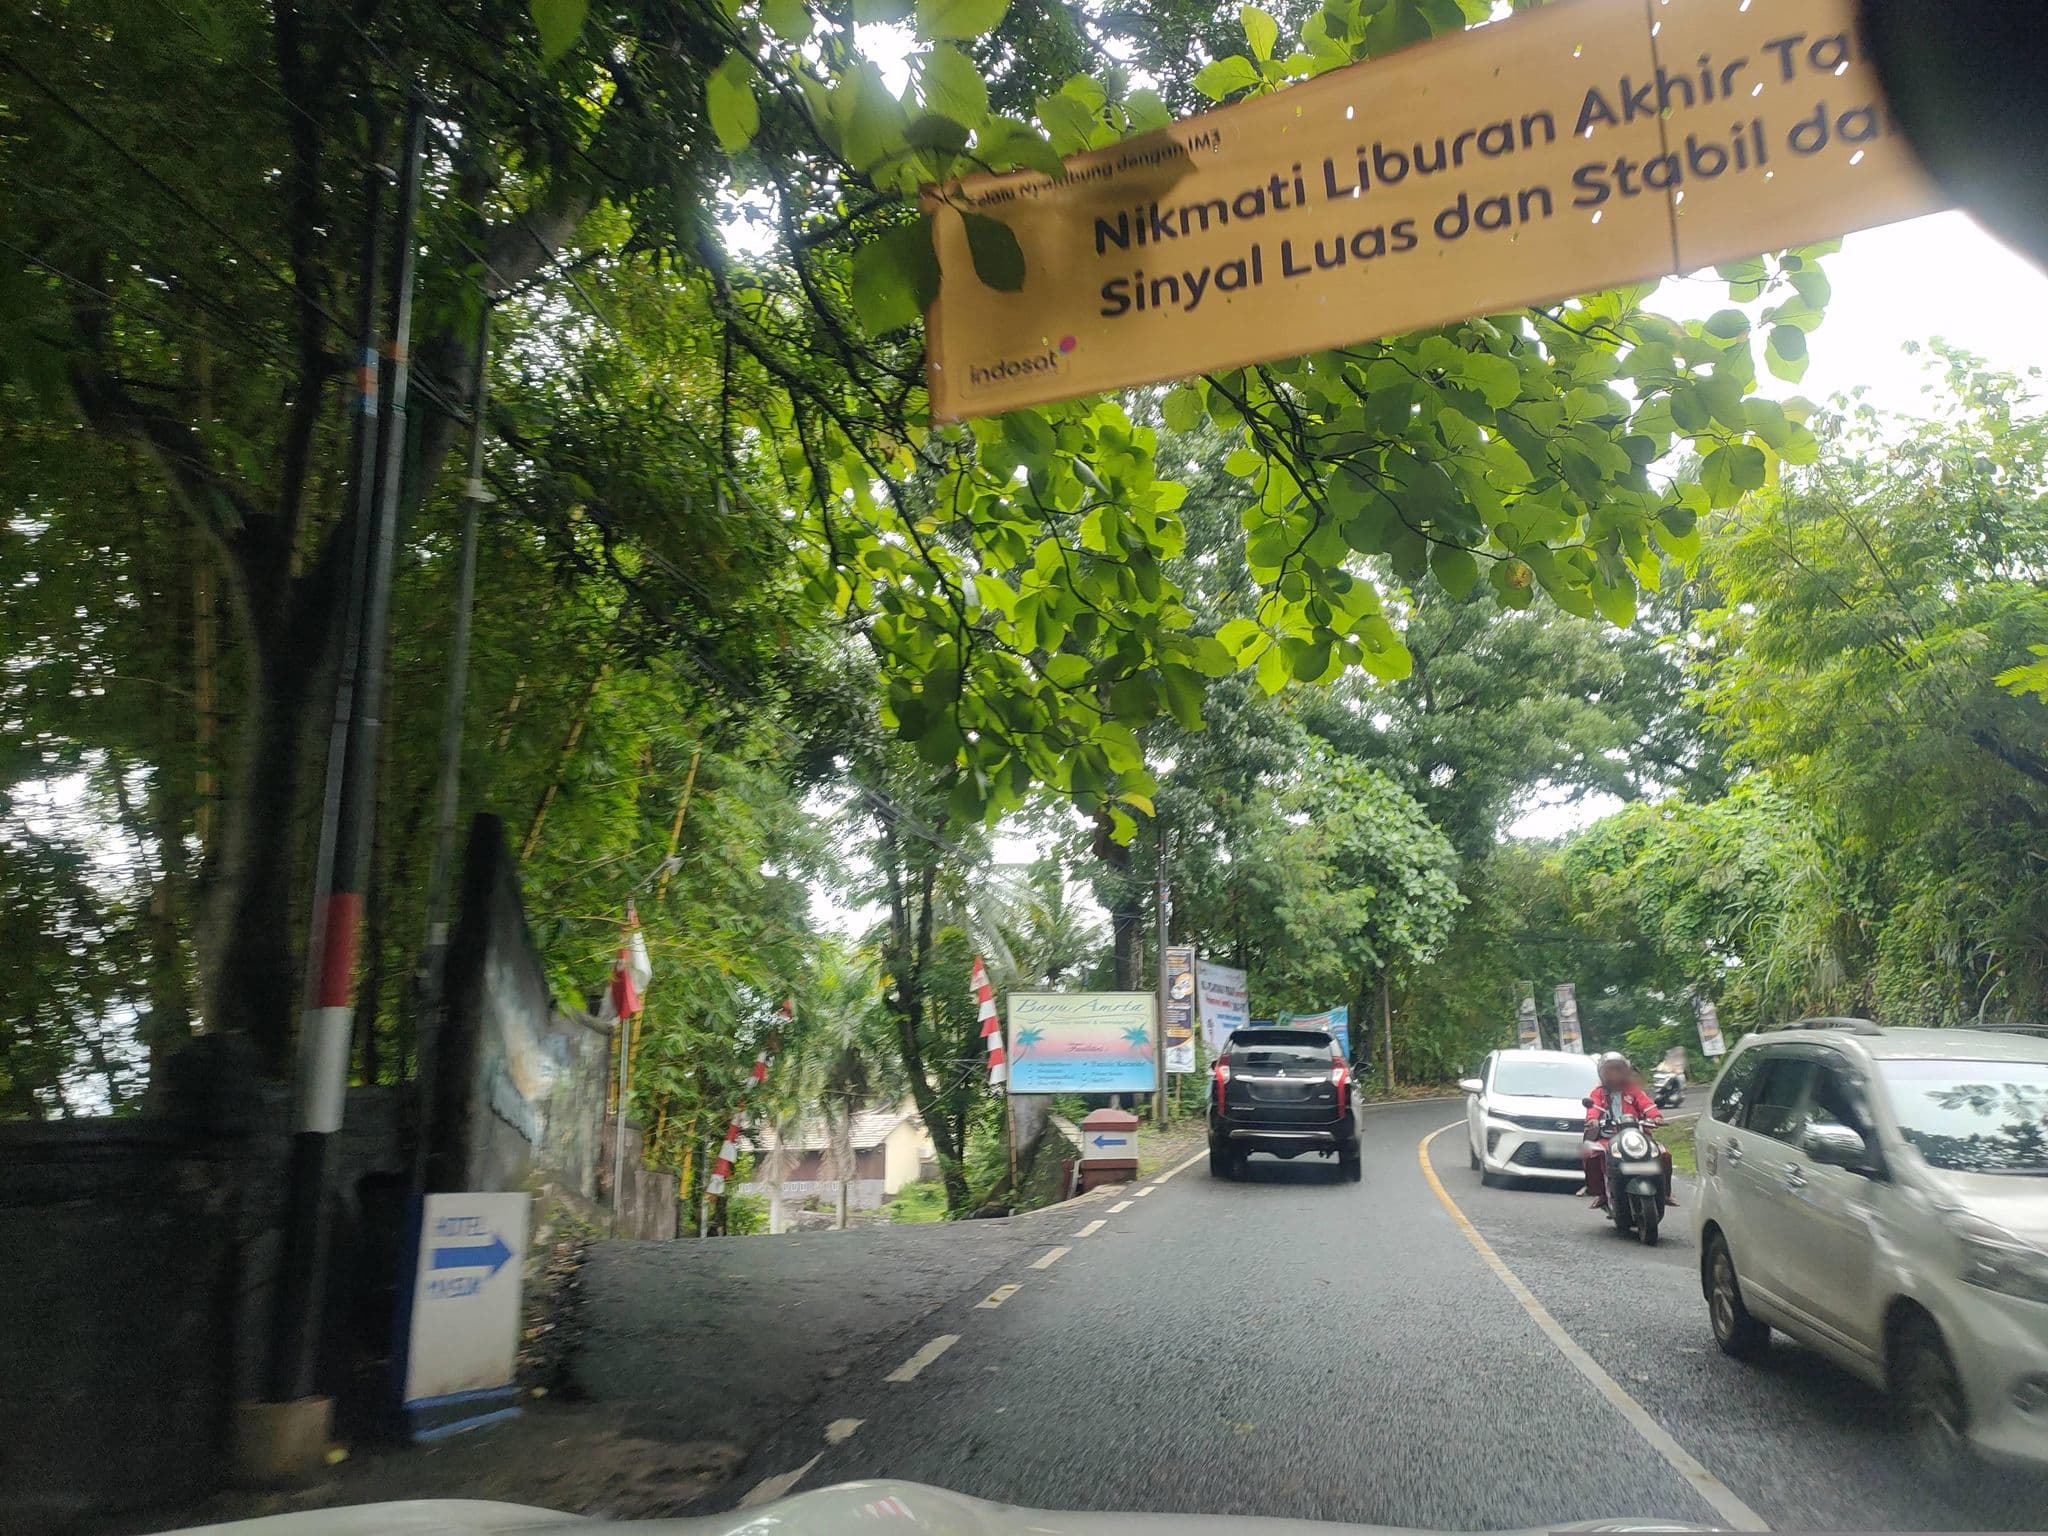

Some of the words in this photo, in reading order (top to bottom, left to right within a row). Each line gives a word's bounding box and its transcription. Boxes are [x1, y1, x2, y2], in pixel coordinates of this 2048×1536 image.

[1094, 163, 1306, 256] Nikmati
[1323, 111, 1555, 201] Liburan
[1574, 52, 1750, 137] Akhir
[1762, 30, 1849, 82] Ta
[1117, 143, 1185, 172] dengan
[1188, 128, 1222, 153] IM3
[1100, 243, 1263, 318] Sinyal
[1281, 219, 1418, 279] Luas
[1434, 184, 1553, 241] dan
[1572, 118, 1766, 208] Stabil
[1787, 100, 1880, 156] da
[969, 350, 1058, 385] indosat
